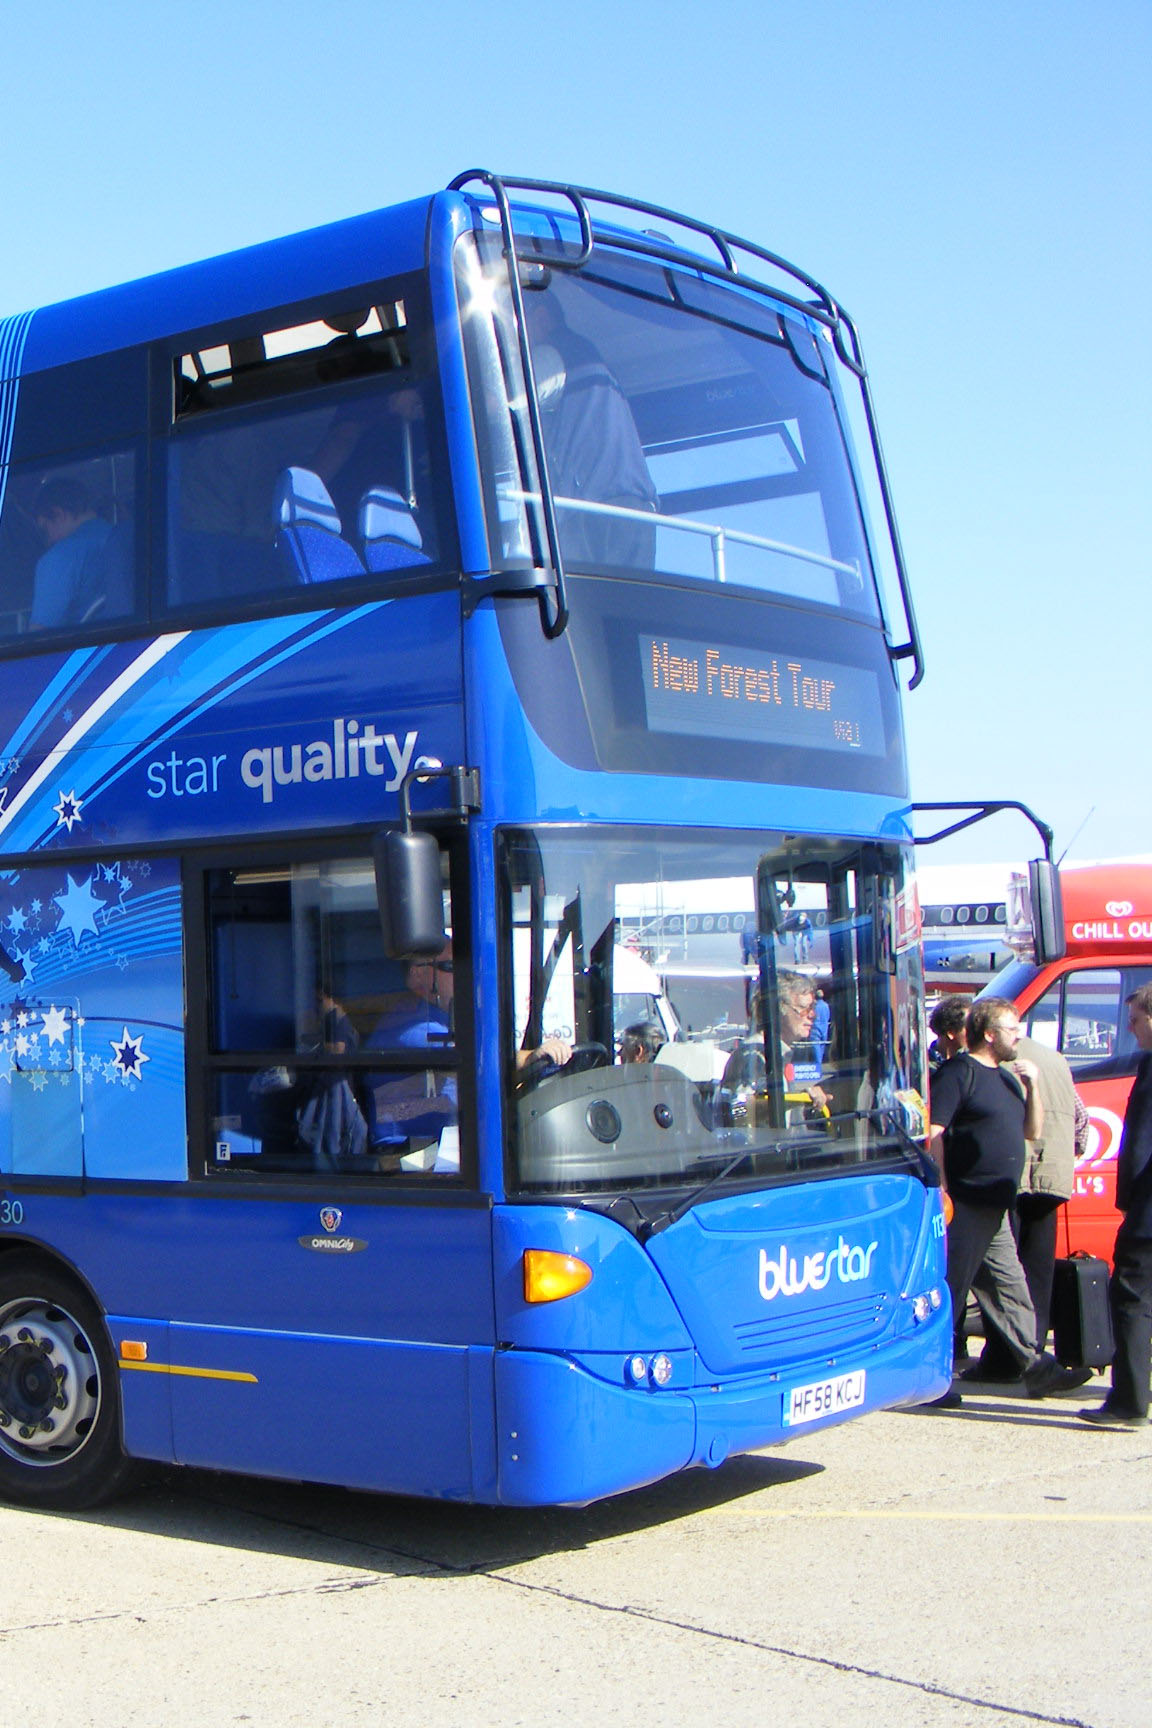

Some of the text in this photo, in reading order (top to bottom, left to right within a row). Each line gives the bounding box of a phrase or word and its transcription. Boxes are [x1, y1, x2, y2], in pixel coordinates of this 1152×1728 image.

[652, 640, 835, 711] New Forest Tour
[147, 718, 419, 803] star quality
[1072, 921, 1152, 939] CHILL OU
[1071, 1176, 1104, 1194] L'S
[932, 1212, 945, 1239] 113
[758, 1235, 879, 1300] bluestar
[793, 1375, 863, 1418] HF58 KCJ
